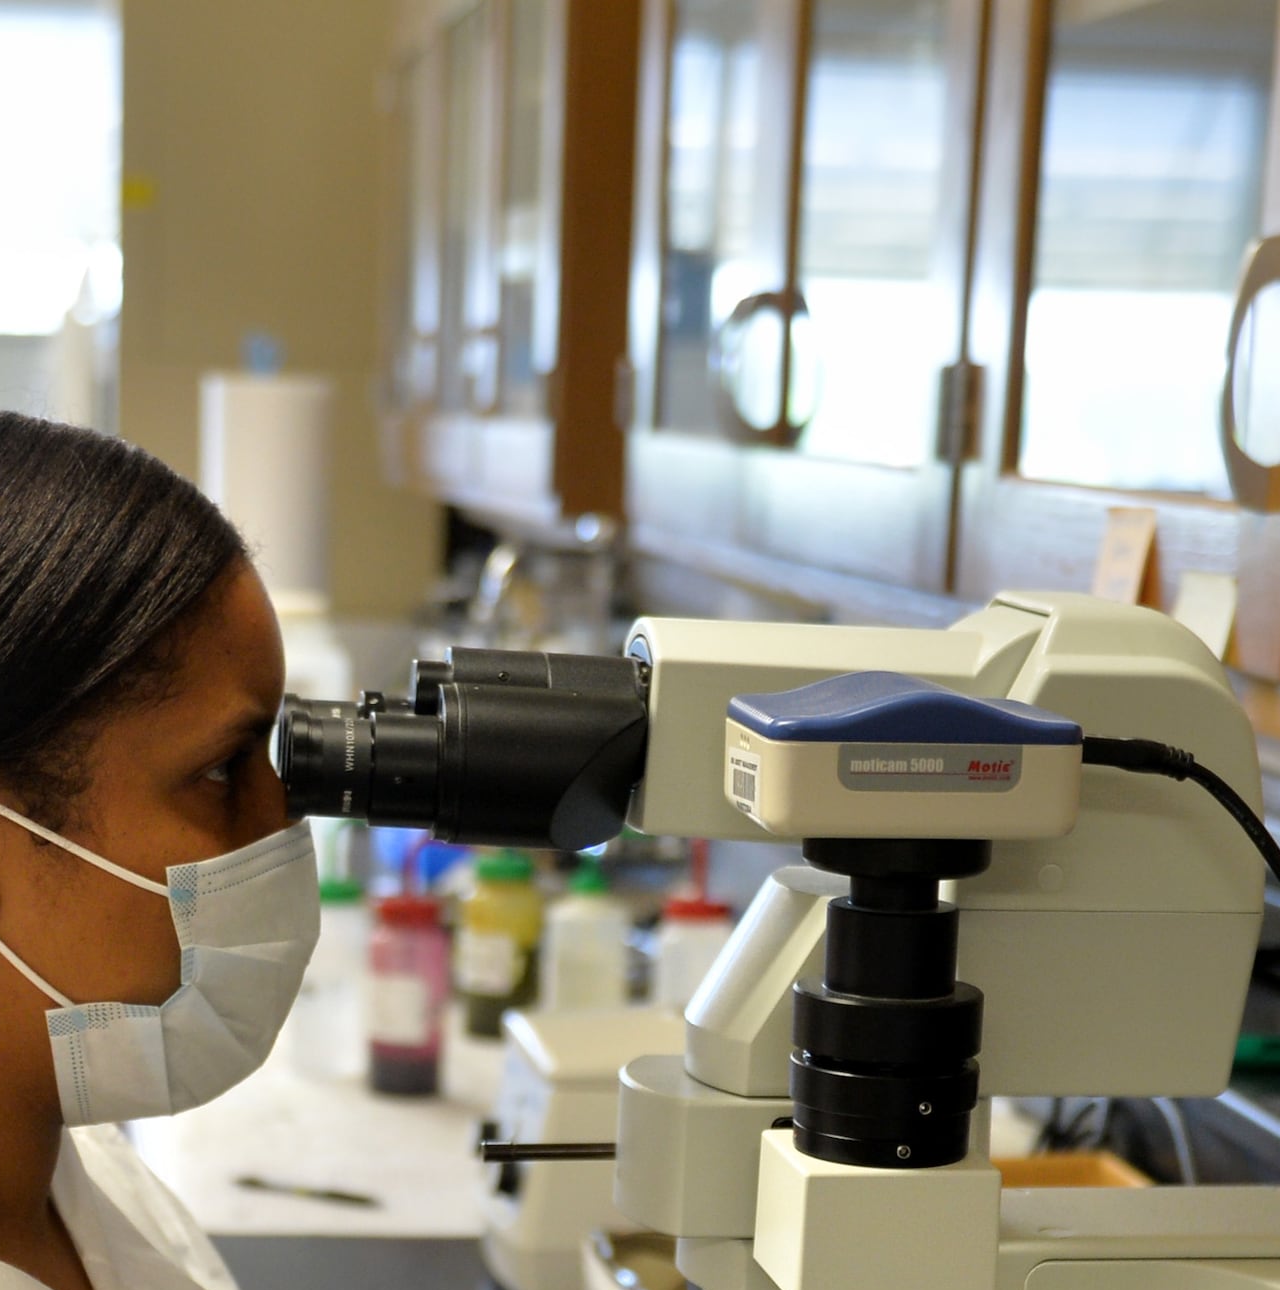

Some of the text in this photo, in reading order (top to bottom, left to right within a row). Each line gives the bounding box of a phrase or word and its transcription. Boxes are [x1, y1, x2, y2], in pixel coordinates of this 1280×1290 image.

[850, 758, 944, 773] moticam 5000
[967, 760, 1011, 774] Motic
